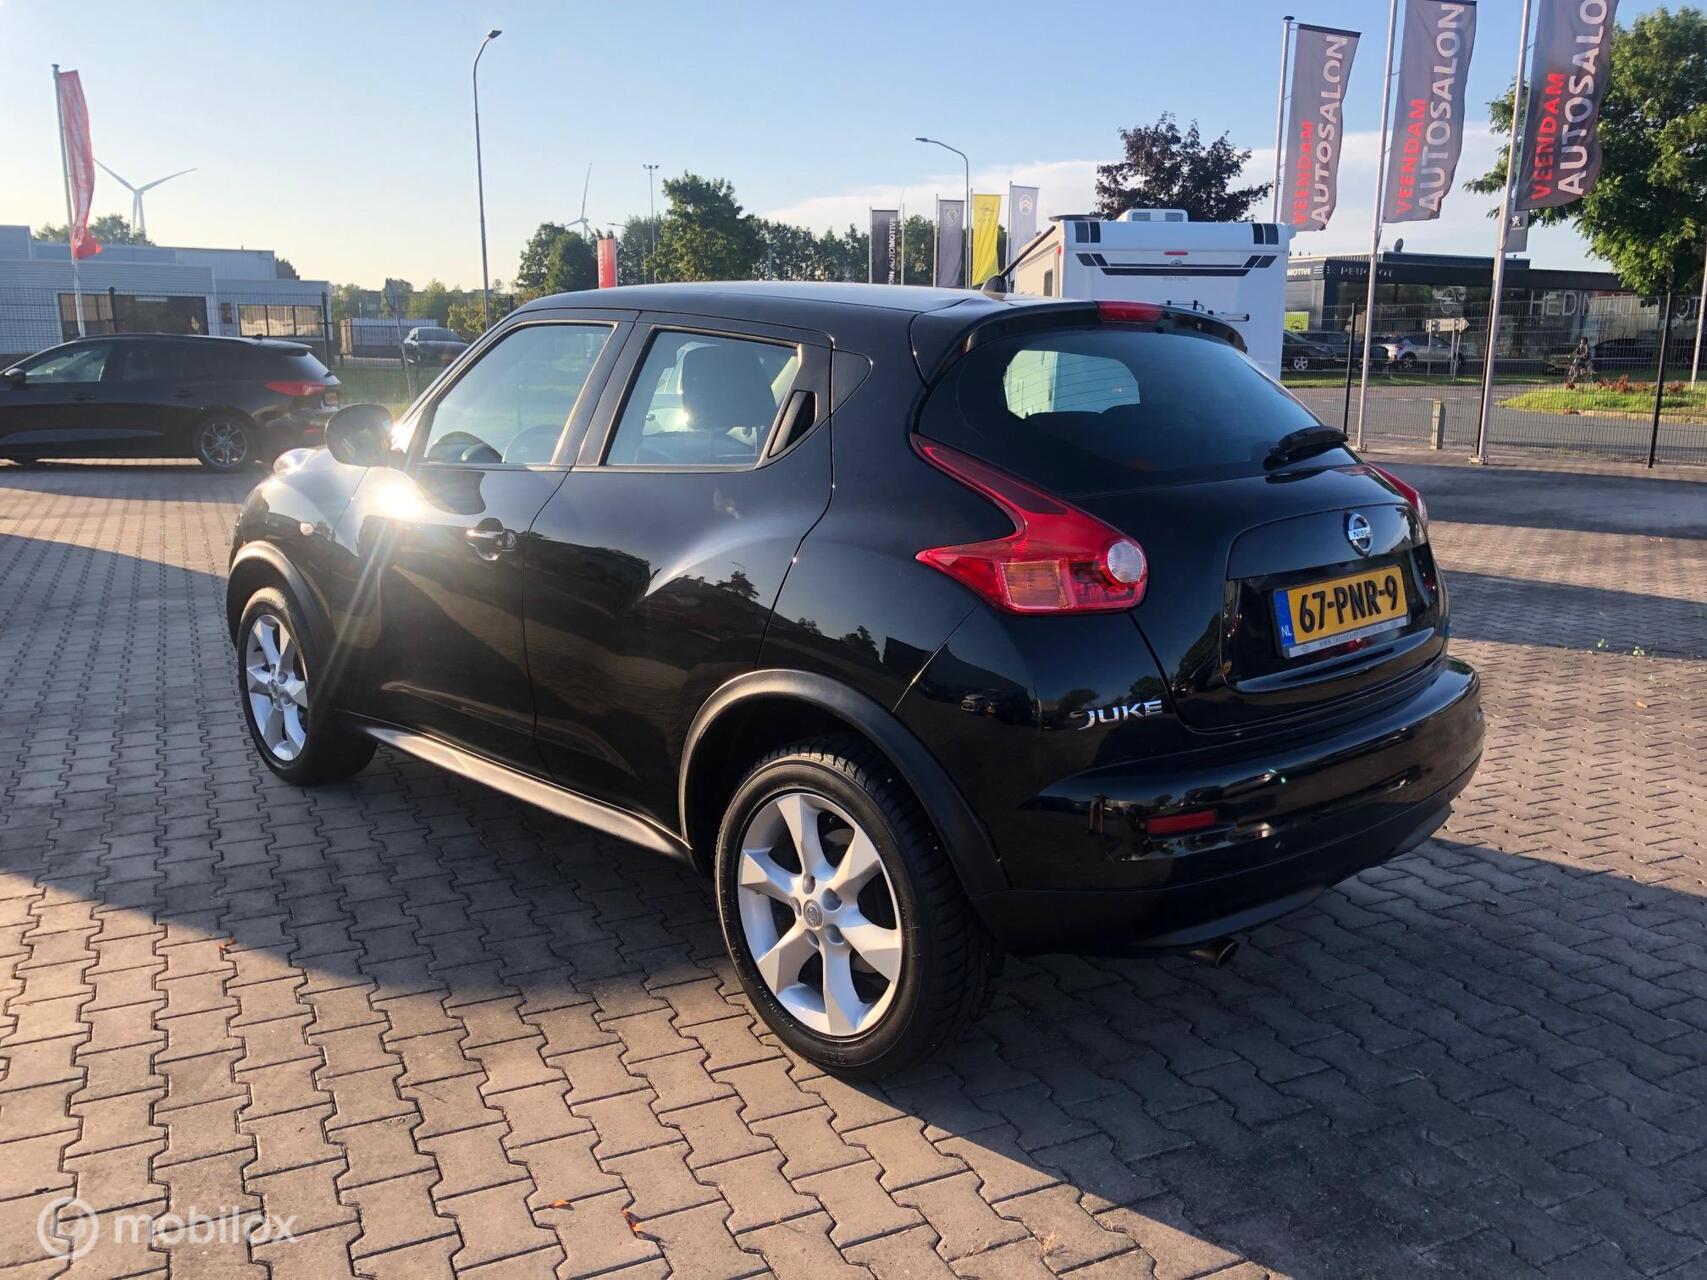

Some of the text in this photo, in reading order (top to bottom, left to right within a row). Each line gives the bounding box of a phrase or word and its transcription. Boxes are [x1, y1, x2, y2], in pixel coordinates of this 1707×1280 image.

[1311, 35, 1348, 225] AUTOSALON
[1395, 98, 1427, 216] VEENDAM
[1418, 3, 1465, 212] AUTOSALON
[1531, 72, 1567, 200] VEENDAM
[1293, 120, 1314, 224] VEENDAM
[1280, 625, 1292, 638] NL
[1299, 575, 1398, 633] 67-PNR-9
[1069, 699, 1162, 731] JUKE
